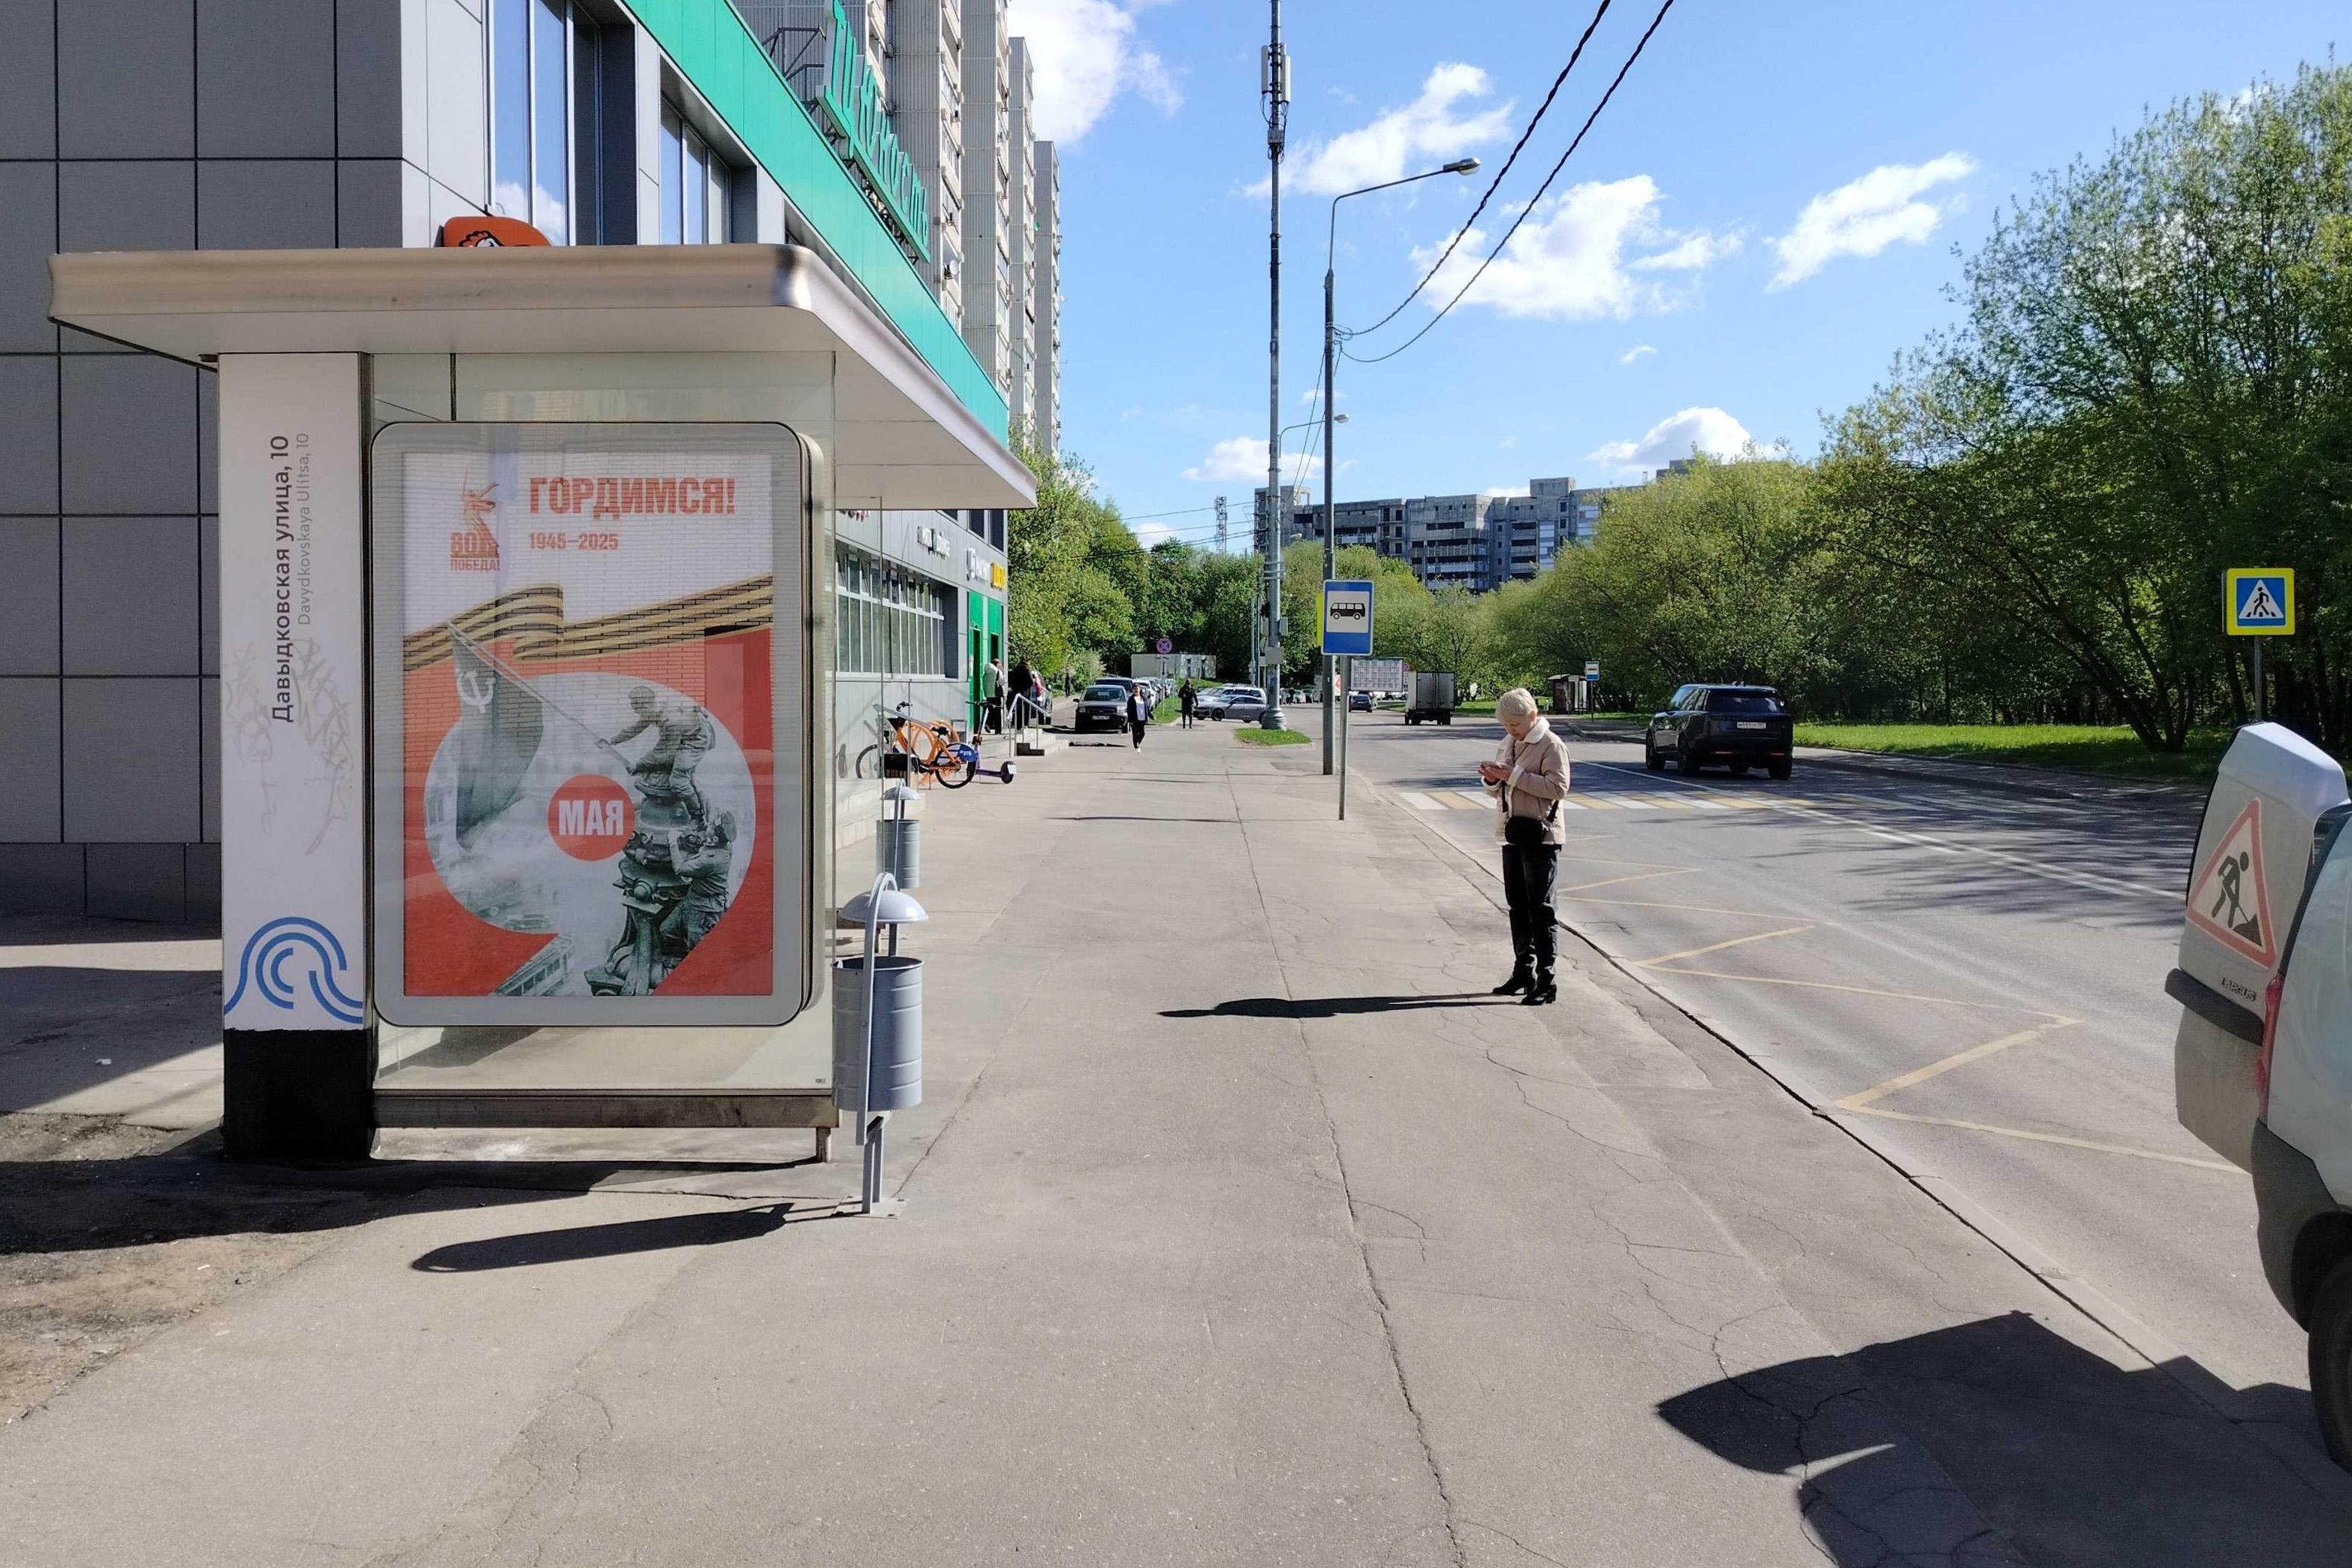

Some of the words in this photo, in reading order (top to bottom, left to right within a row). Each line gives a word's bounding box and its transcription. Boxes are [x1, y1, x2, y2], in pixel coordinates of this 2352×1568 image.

[270, 435, 289, 460] 10
[296, 433, 309, 451] 10
[296, 453, 312, 502] Ulitsa,
[274, 466, 294, 542] улица,
[529, 478, 735, 520] ГОРДИМСЯ!
[297, 507, 315, 626] Davydkovskaya
[451, 559, 500, 571] ПОБЕДА!
[272, 548, 294, 722] Давыдковская
[559, 800, 623, 836] МАЯ
[2221, 977, 2256, 1001] LARGUS
